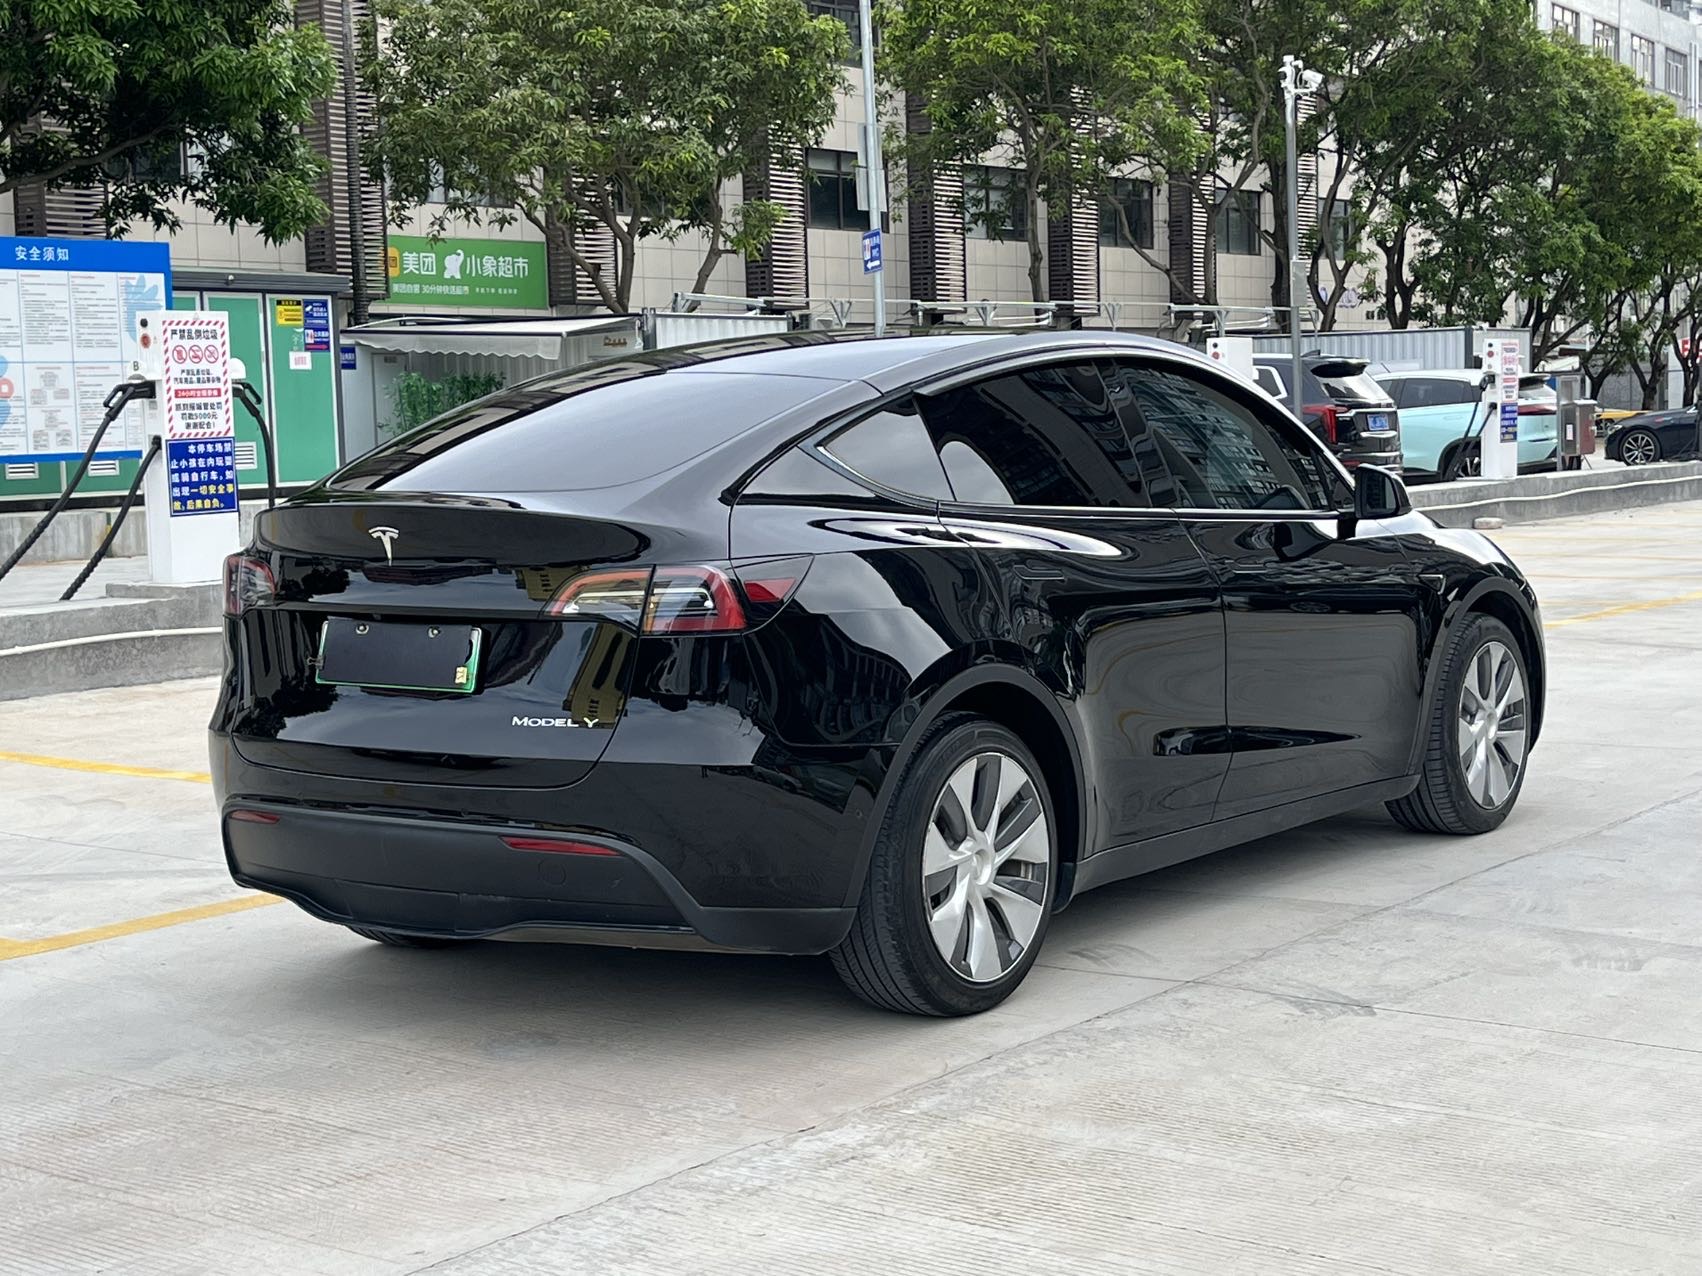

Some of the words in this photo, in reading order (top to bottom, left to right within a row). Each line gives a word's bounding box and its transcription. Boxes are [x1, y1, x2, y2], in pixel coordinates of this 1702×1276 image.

[15, 245, 69, 262] 安全须知
[402, 251, 436, 275] 美团
[466, 254, 529, 279] 小象超市
[171, 328, 218, 341] 严禁乱倒垃圾
[133, 360, 140, 371] B
[188, 442, 232, 454] 本停车场禁
[512, 716, 580, 728] MODEL
[583, 717, 599, 728] Y
